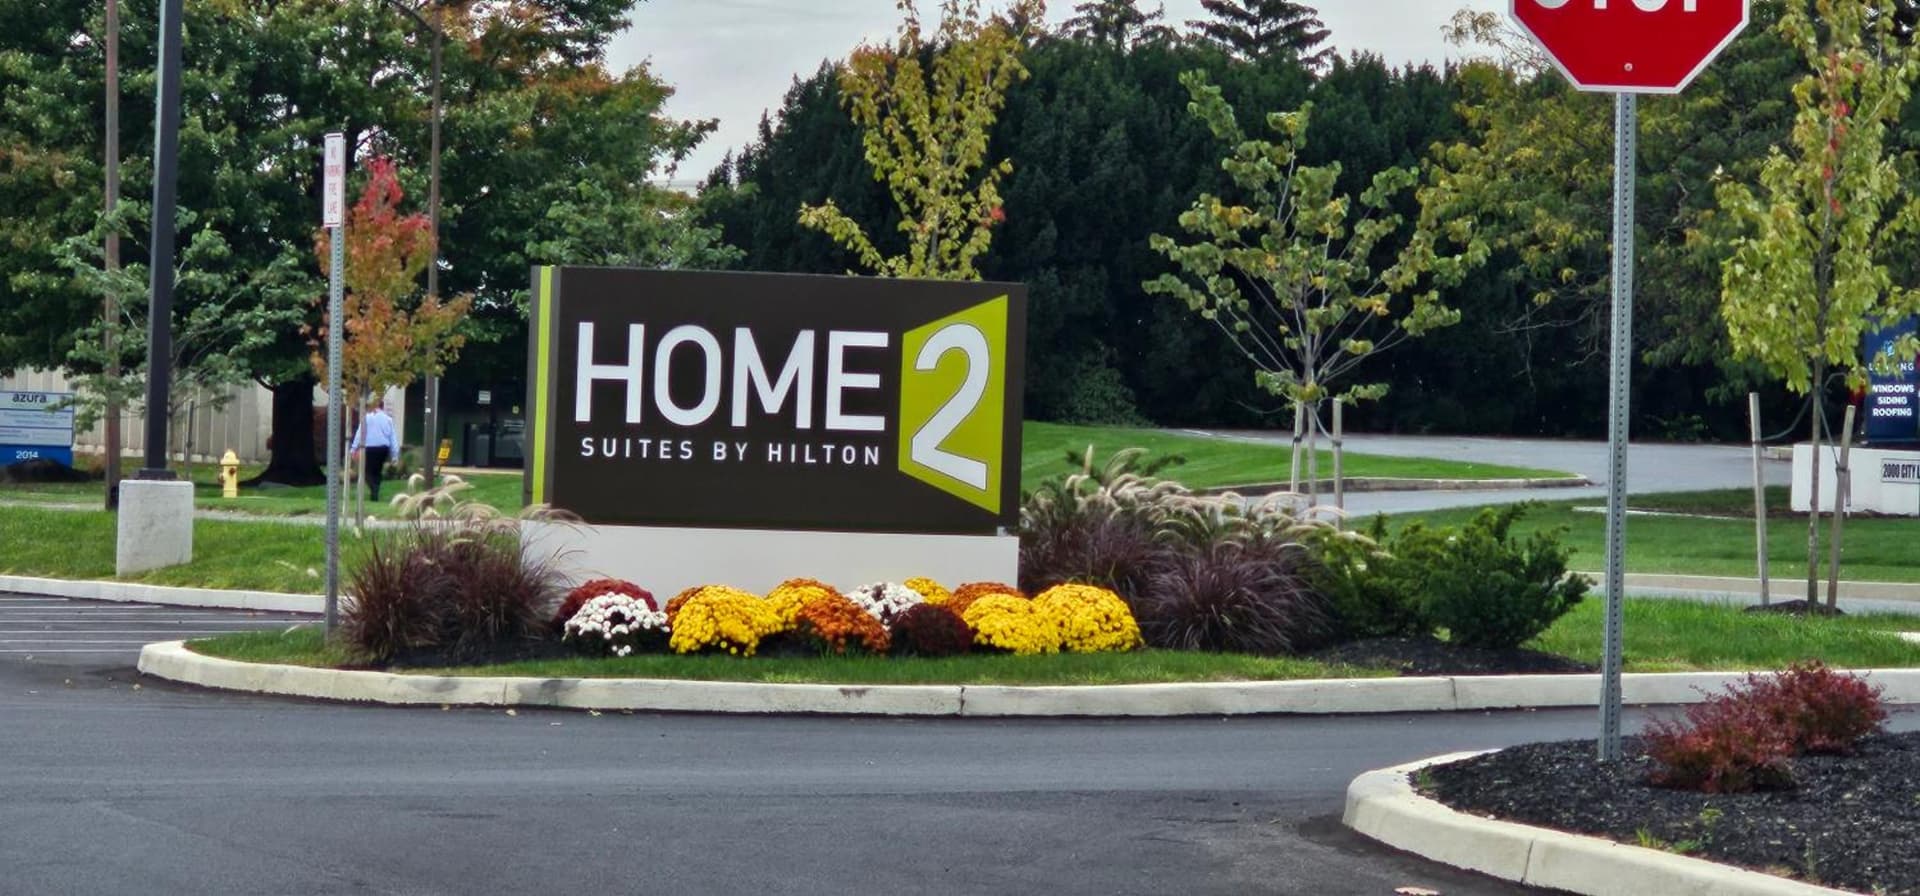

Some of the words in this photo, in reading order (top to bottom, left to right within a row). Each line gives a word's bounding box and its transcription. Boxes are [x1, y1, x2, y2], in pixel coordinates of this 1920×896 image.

[12, 393, 47, 403] azura
[575, 322, 888, 430] HOME
[911, 322, 990, 491] 2
[1872, 408, 1912, 417] ROOFING
[15, 450, 39, 459] 2014
[581, 437, 694, 459] SUITES
[713, 442, 748, 462] BY
[768, 443, 880, 465] HILTON
[1901, 463, 1916, 478] CITY
